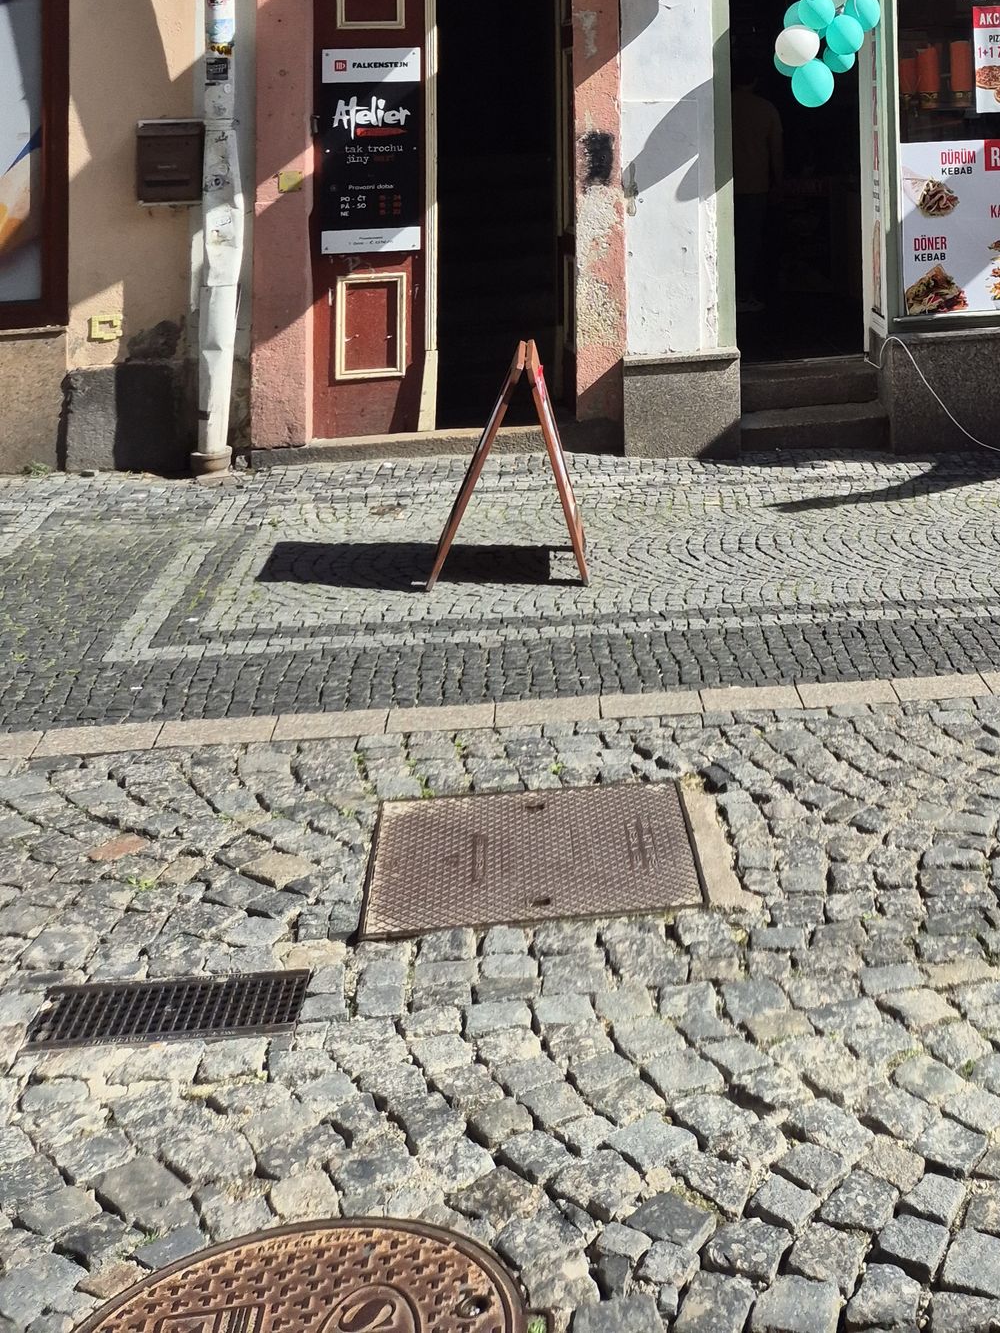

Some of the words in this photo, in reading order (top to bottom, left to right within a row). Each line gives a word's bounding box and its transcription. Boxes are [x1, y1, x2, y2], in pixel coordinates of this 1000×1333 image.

[978, 46, 994, 58] 1+1
[332, 96, 411, 140] Atelier
[345, 145, 363, 153] tak
[368, 144, 403, 153] trochu
[940, 148, 976, 165] DÜRÜM
[941, 166, 973, 175] KEBAB
[913, 235, 947, 251] DÖNER
[914, 252, 946, 262] KEBAB
